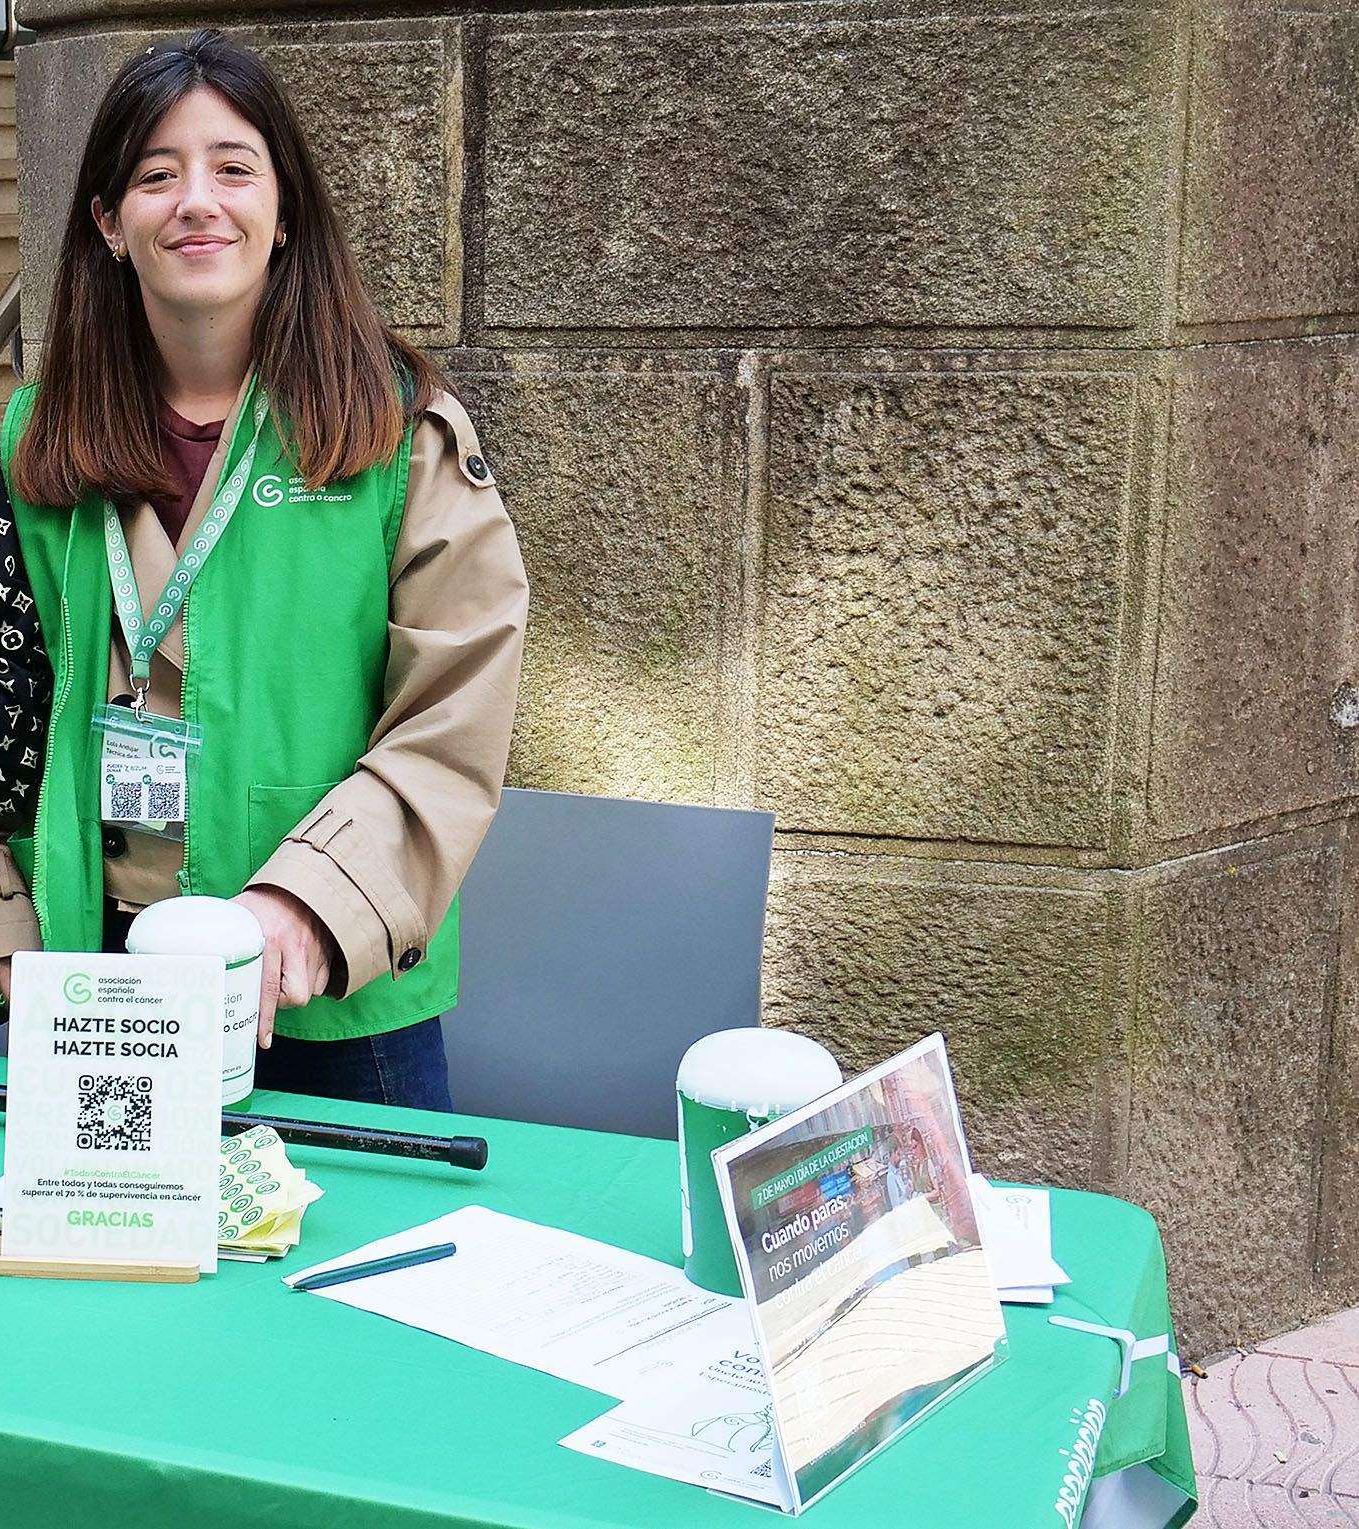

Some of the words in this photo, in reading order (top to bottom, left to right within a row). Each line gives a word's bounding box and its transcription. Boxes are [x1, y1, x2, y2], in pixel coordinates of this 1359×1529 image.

[289, 494, 315, 503] contra
[323, 494, 352, 502] cancro
[98, 976, 142, 985] asociación
[98, 986, 136, 995] española
[135, 996, 163, 1004] cáncer
[53, 1017, 115, 1033] HAZTE
[120, 1019, 180, 1035] SOCIO
[53, 1040, 115, 1056] HAZTE
[120, 1042, 179, 1058] SOCIA
[37, 1178, 60, 1186] Entre
[62, 1179, 85, 1187] todos
[87, 1181, 94, 1189] y
[119, 1182, 184, 1191] conseguiremos
[756, 1192, 763, 1205] 7
[763, 1187, 775, 1200] DE
[774, 1177, 795, 1194] MAYO
[809, 1162, 820, 1176] DE
[819, 1158, 829, 1171] LA
[21, 1188, 54, 1197] superar
[65, 1190, 76, 1198] 70
[77, 1190, 85, 1198] %
[86, 1190, 98, 1198] de
[99, 1191, 157, 1200] supervivencia
[172, 1193, 201, 1202] cáncer
[67, 1210, 154, 1228] GRACIAS
[761, 1213, 810, 1254] Cuando
[768, 1256, 792, 1282] nos
[792, 1222, 850, 1267] movemos
